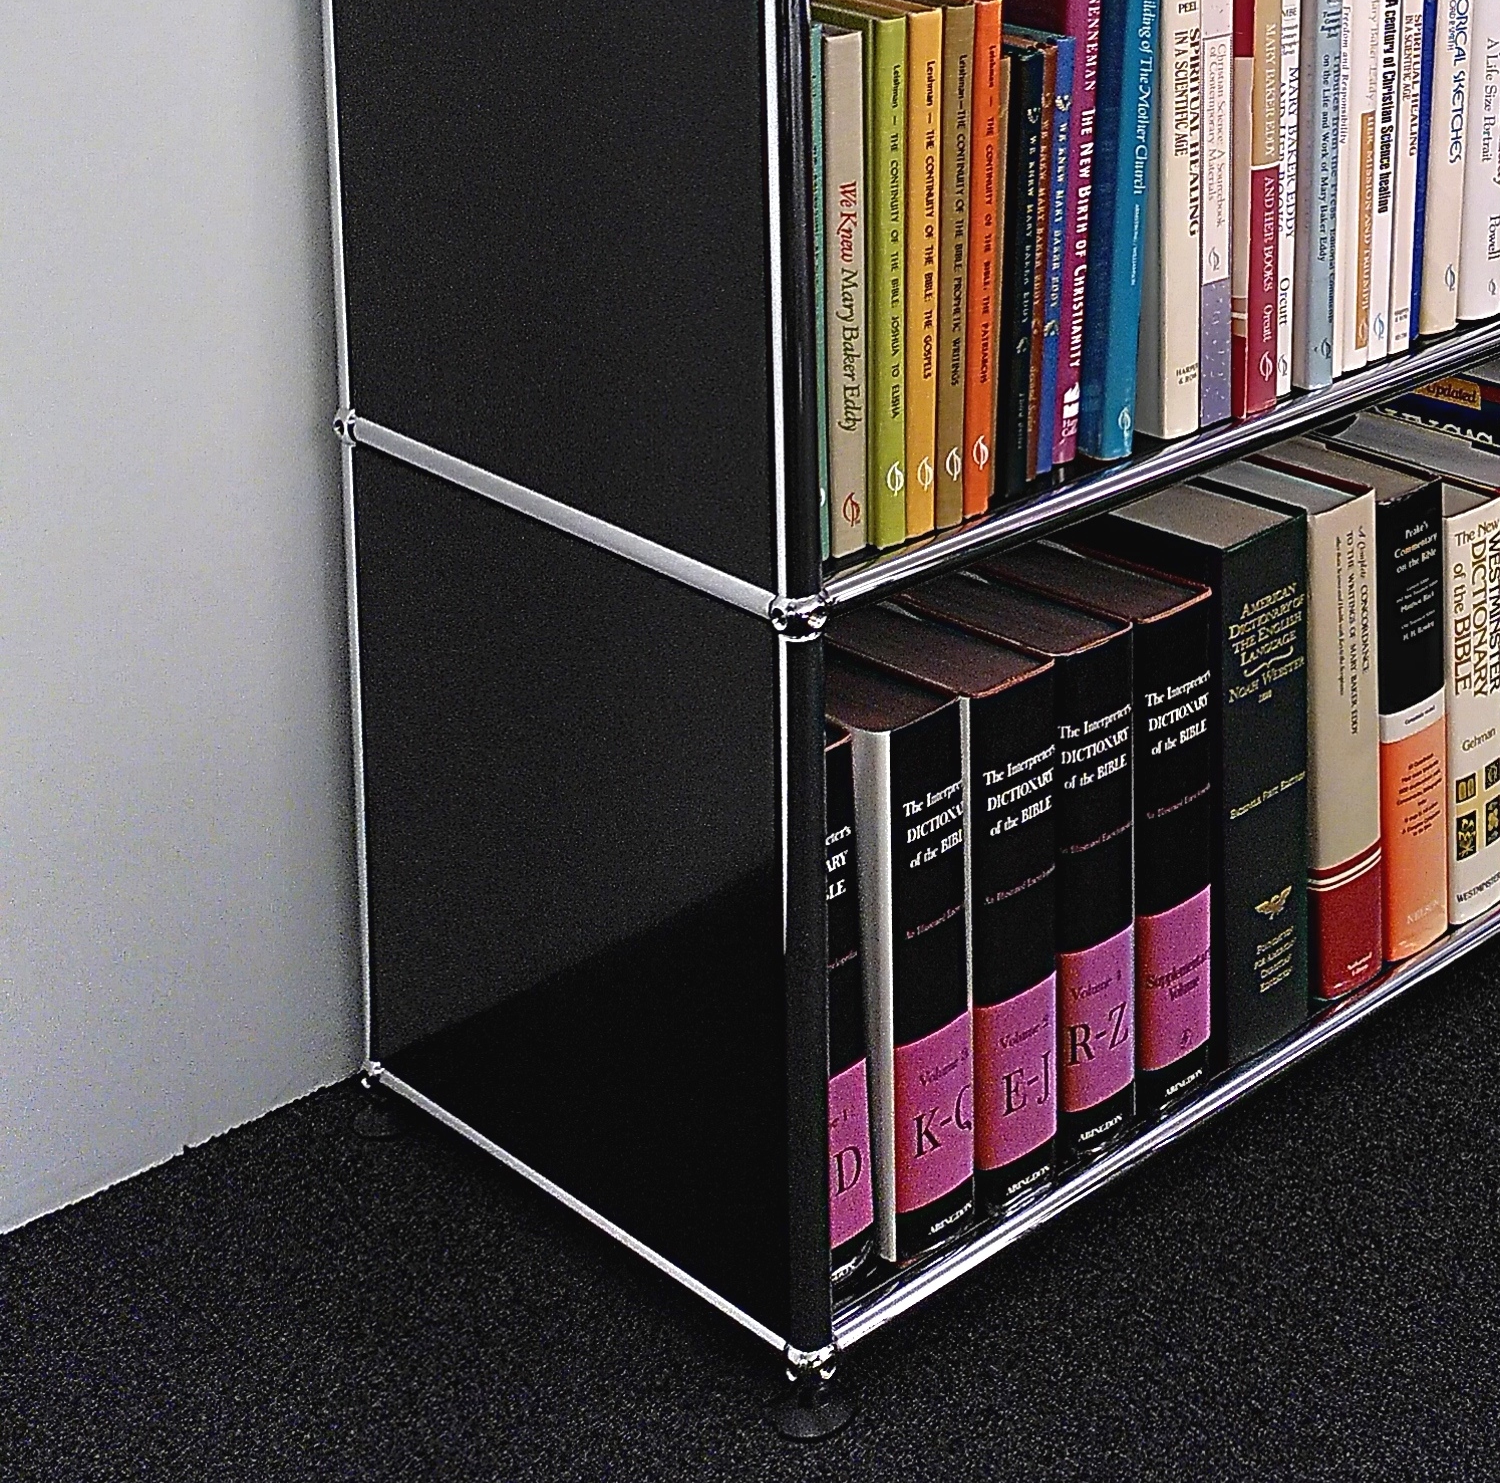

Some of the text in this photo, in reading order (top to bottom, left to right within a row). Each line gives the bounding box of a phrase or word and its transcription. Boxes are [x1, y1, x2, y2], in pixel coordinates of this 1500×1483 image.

[1179, 2, 1198, 14] PEEL
[1340, 48, 1350, 68] and
[891, 64, 901, 109] Leishman
[1174, 31, 1189, 157] IN A SCIENTIFIC AGE
[1378, 0, 1399, 214] A century of Christian Science healing
[1482, 37, 1499, 162] A Life Size Portrait
[1080, 107, 1096, 136] THE
[1135, 85, 1152, 144] Mother
[1188, 28, 1201, 238] SPIRITUAL HEALING
[1449, 71, 1466, 164] SKETCHES
[890, 132, 898, 153] THE
[1080, 142, 1094, 178] NEW
[1133, 144, 1148, 196] Church
[1263, 23, 1277, 342] MARY BAKER EDDY AND HER BOOKS Orcutt
[890, 160, 899, 223] CONTINUITY
[1075, 184, 1092, 234] BIRTH
[890, 229, 898, 246] OF
[1075, 239, 1087, 258] OF
[1488, 214, 1500, 260] Powell
[890, 251, 900, 273] THE
[835, 181, 863, 432] We Knew Mary Baker Eddy
[1069, 264, 1087, 368] CHRISTIANITY
[1280, 277, 1290, 326] Orcutt
[890, 316, 900, 357] JOSHUA
[891, 362, 900, 378] TO
[891, 384, 901, 420] ELISHA
[1394, 532, 1437, 559] Commentary
[1455, 519, 1499, 547] The New
[1396, 561, 1407, 574] on
[1408, 555, 1420, 567] the
[1228, 599, 1290, 640] DICTIONARY
[1240, 582, 1297, 620] AMERICAN
[1471, 540, 1488, 698] DICTIONARY
[1488, 534, 1500, 694] WESTMINSTER
[1232, 610, 1303, 654] THE ENGLISH
[1240, 630, 1297, 667] LANGUAGE
[1453, 563, 1472, 696] of the BIBLE
[1145, 692, 1164, 707] The
[1228, 656, 1305, 703] NOAH WEBSTER
[1149, 693, 1210, 732] DICTIONARY
[1152, 718, 1208, 756] of the BIBLE
[1462, 727, 1496, 752] Gehman
[983, 770, 1004, 786] The
[987, 768, 1054, 811] DICTIONARY
[990, 796, 1053, 836] of the BIBLE
[1456, 872, 1500, 904] WESTMINSTER
[1066, 1001, 1129, 1067] R-Z
[1002, 1050, 1052, 1117] E-J
